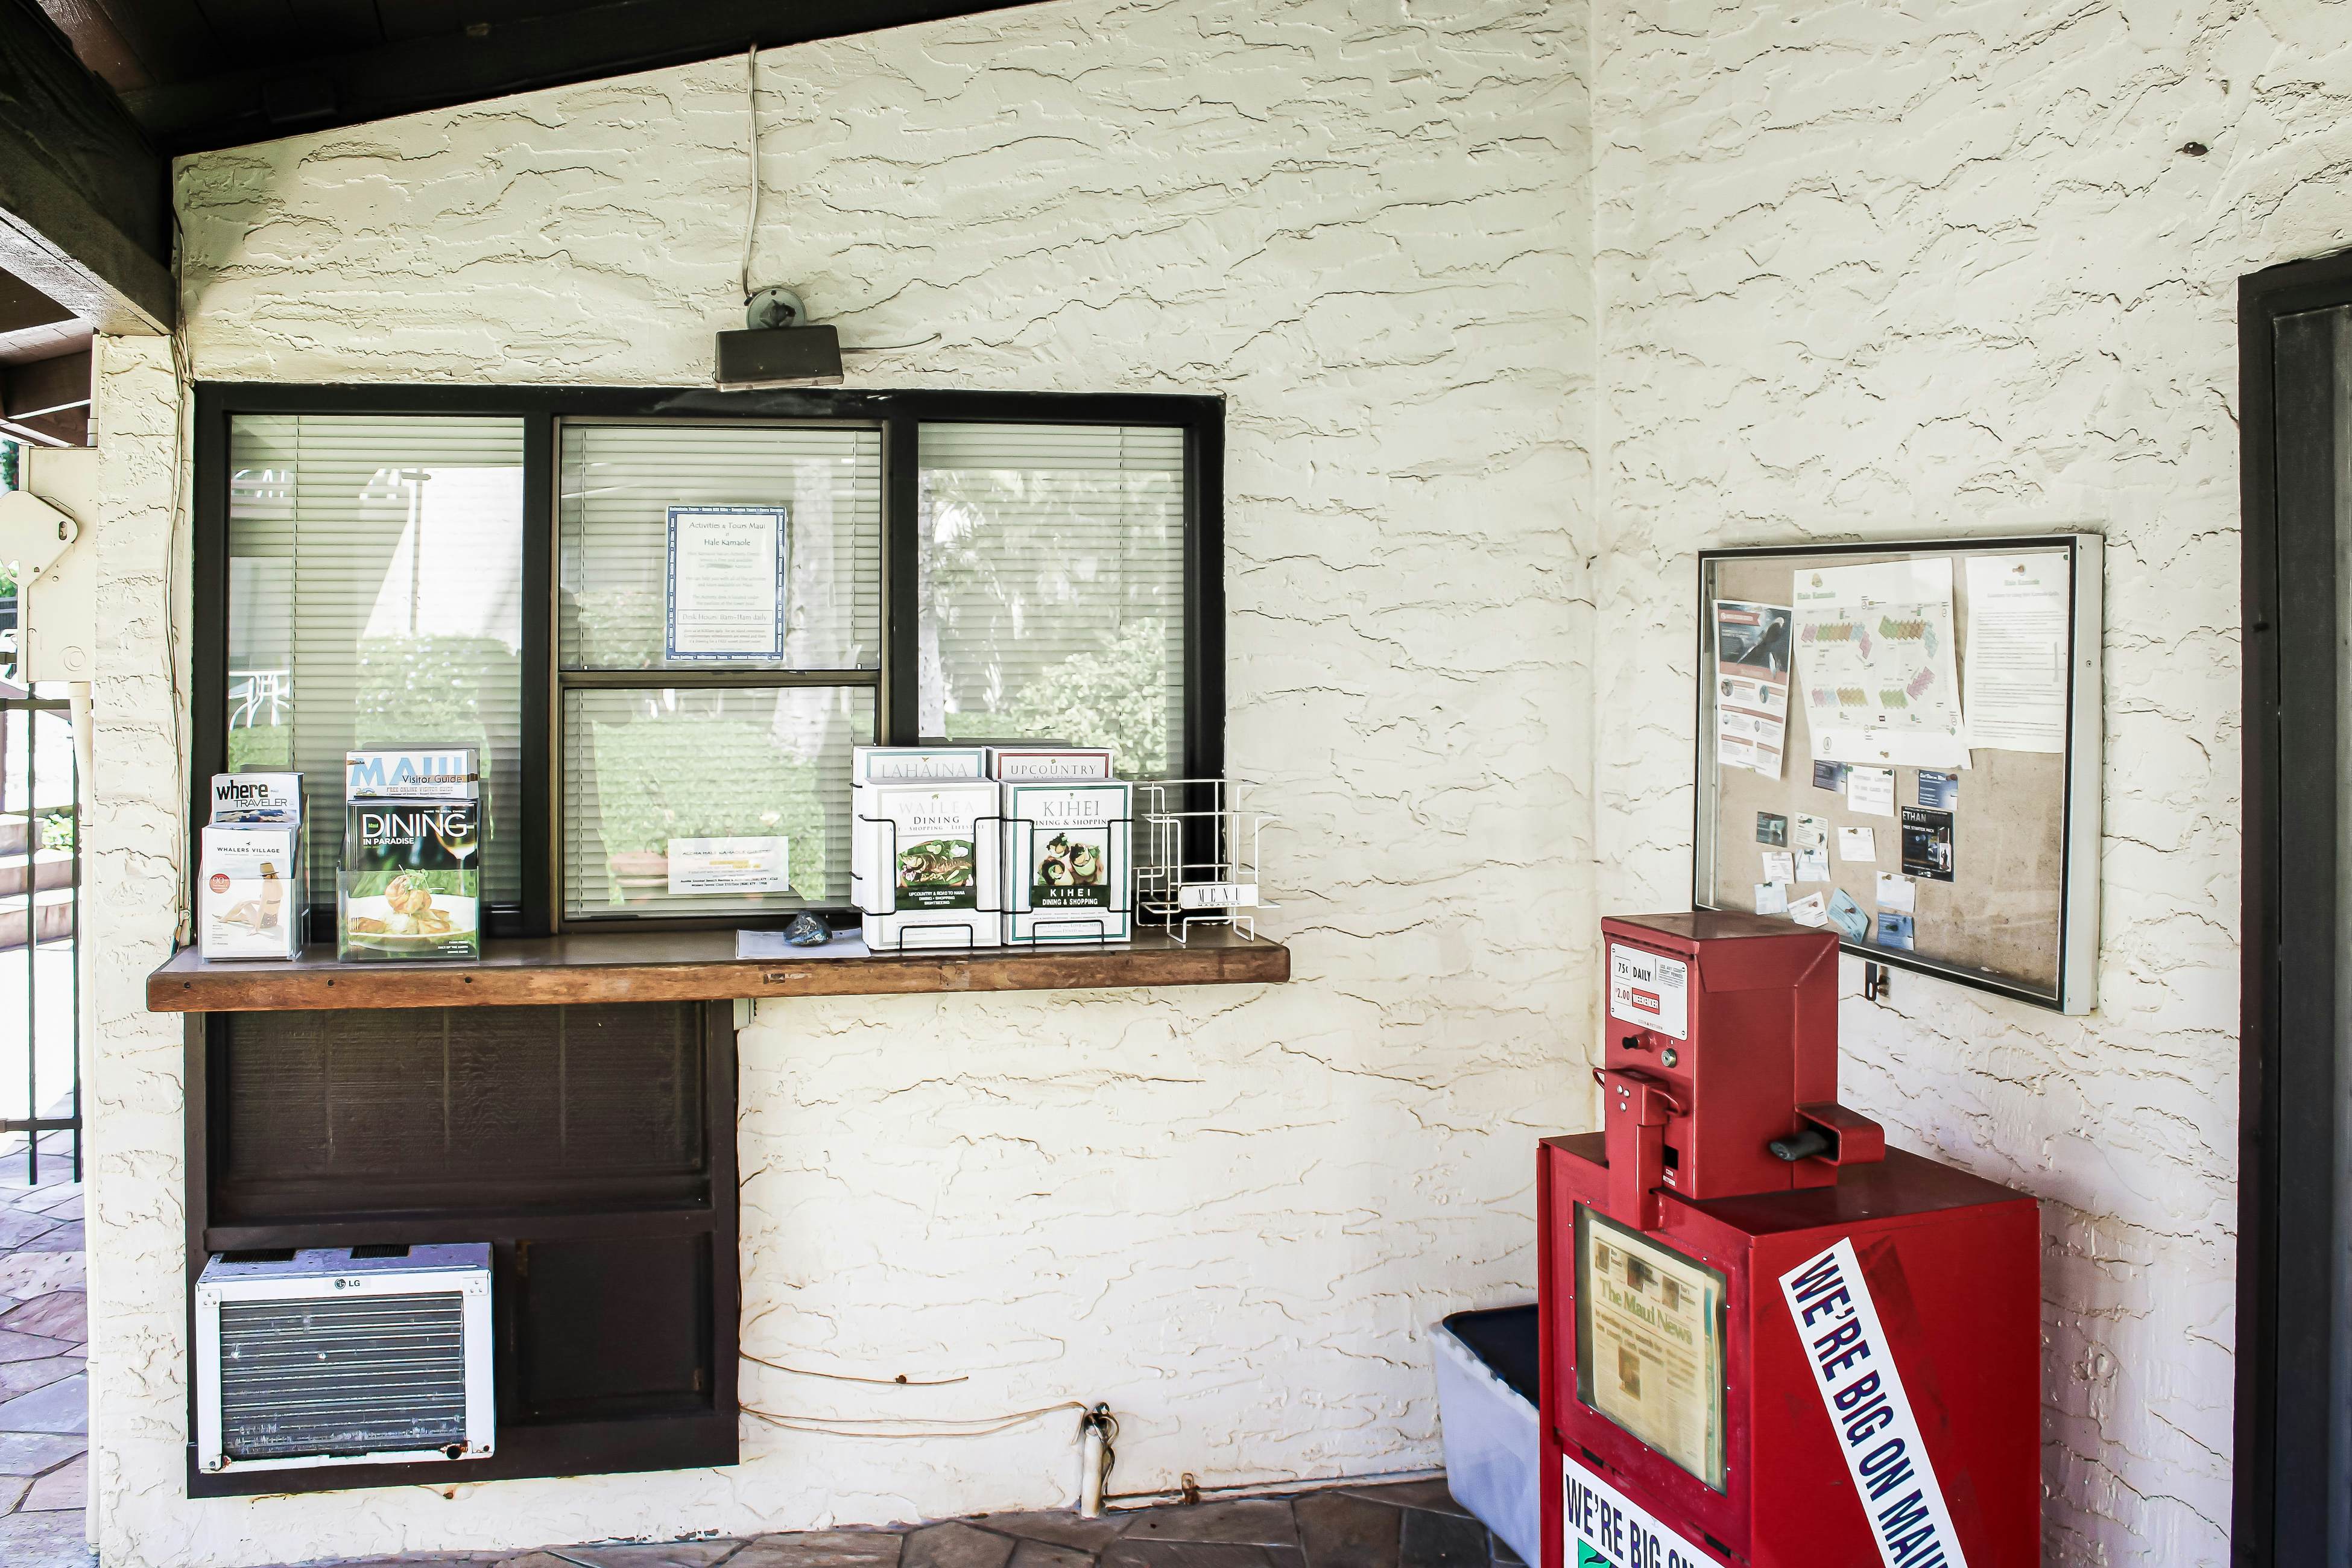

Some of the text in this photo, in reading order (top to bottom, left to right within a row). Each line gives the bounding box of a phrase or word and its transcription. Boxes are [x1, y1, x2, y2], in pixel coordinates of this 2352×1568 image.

[350, 757, 462, 786] MAUI
[882, 763, 969, 778] LAHAINA
[1011, 765, 1096, 775] UPCOUNTRY
[402, 775, 463, 783] Visitor Guide
[216, 779, 268, 800] where
[233, 798, 288, 808] TRAVELER
[899, 801, 975, 814] WAILEA
[1043, 800, 1099, 817] KIHEI
[914, 816, 960, 824] DINING
[1902, 811, 1926, 823] ETHAN
[362, 813, 468, 838] DINING
[1050, 888, 1090, 897] KIHEI
[1633, 966, 1651, 982] DAILY
[1599, 1277, 1622, 1307] The
[1623, 1291, 1655, 1326] Maui
[1657, 1307, 1693, 1345] News
[1791, 1252, 1949, 1568] WE'RE BIG ON MAU
[1566, 1473, 1661, 1568] WE'RE BIG
